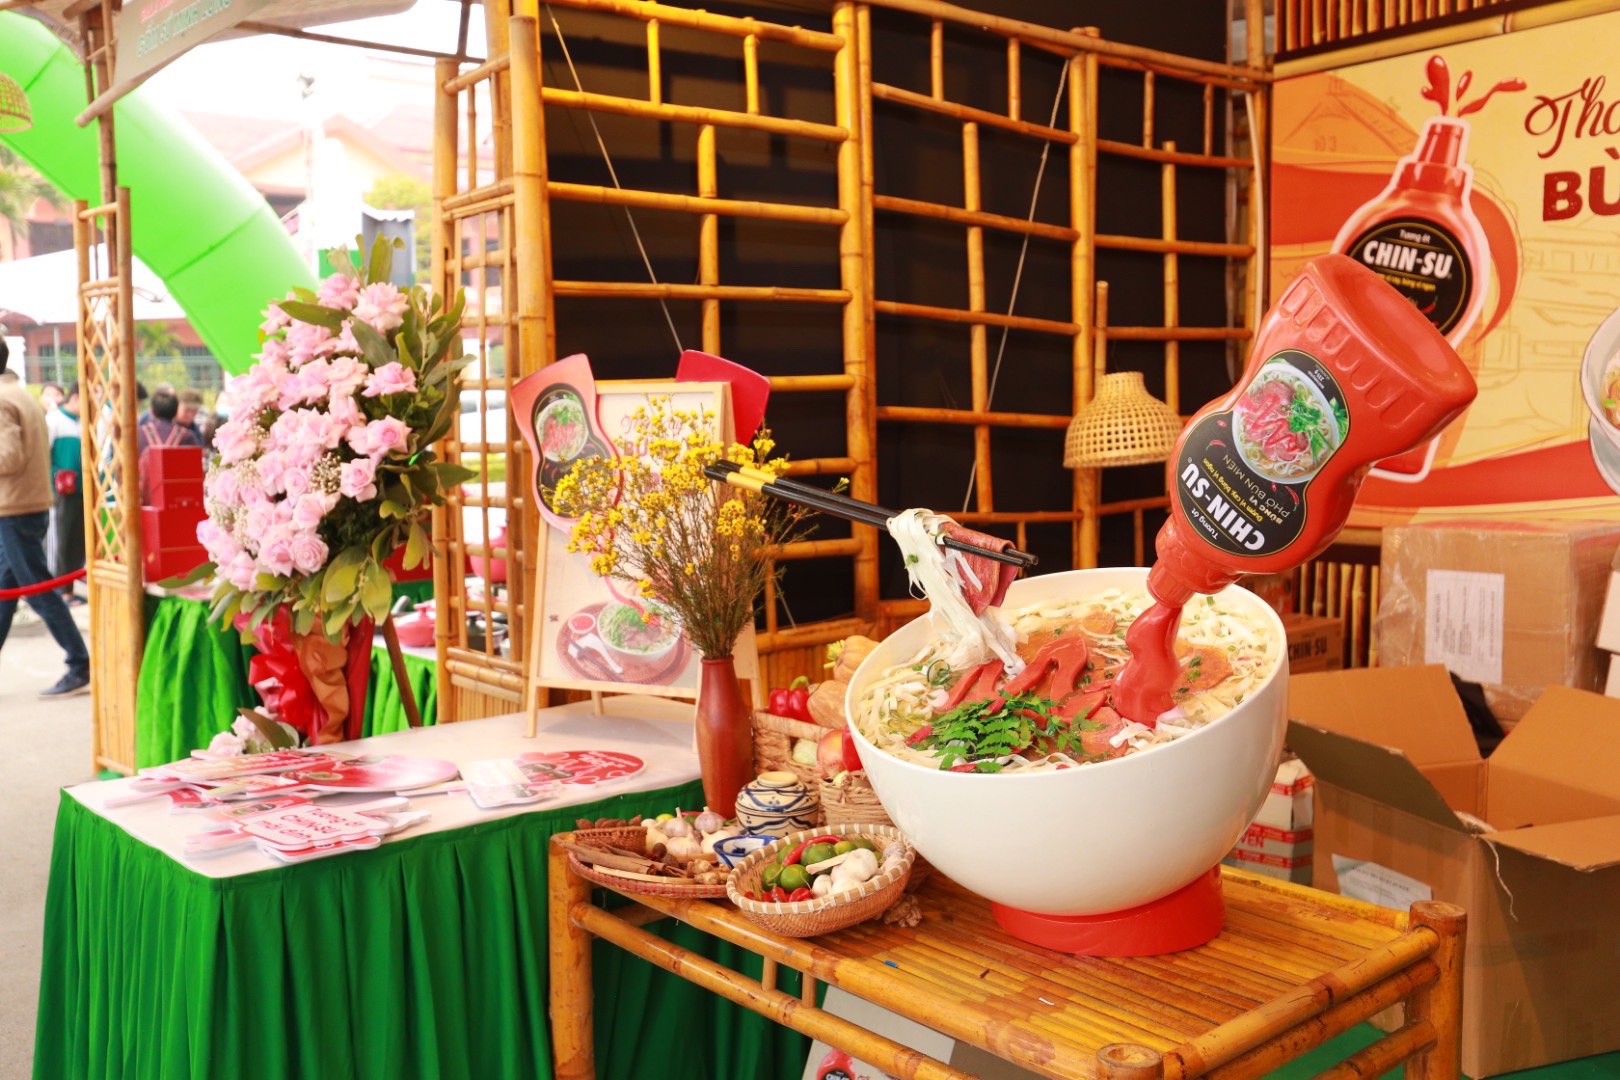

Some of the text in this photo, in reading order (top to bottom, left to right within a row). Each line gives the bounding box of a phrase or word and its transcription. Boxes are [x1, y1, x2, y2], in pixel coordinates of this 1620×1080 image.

[1363, 240, 1453, 279] CHIN-SU
[1244, 478, 1267, 501] BÚN
[1181, 463, 1265, 551] CHIN-SU
[1259, 504, 1284, 525] BÙNG
[1199, 515, 1219, 540] Tương
